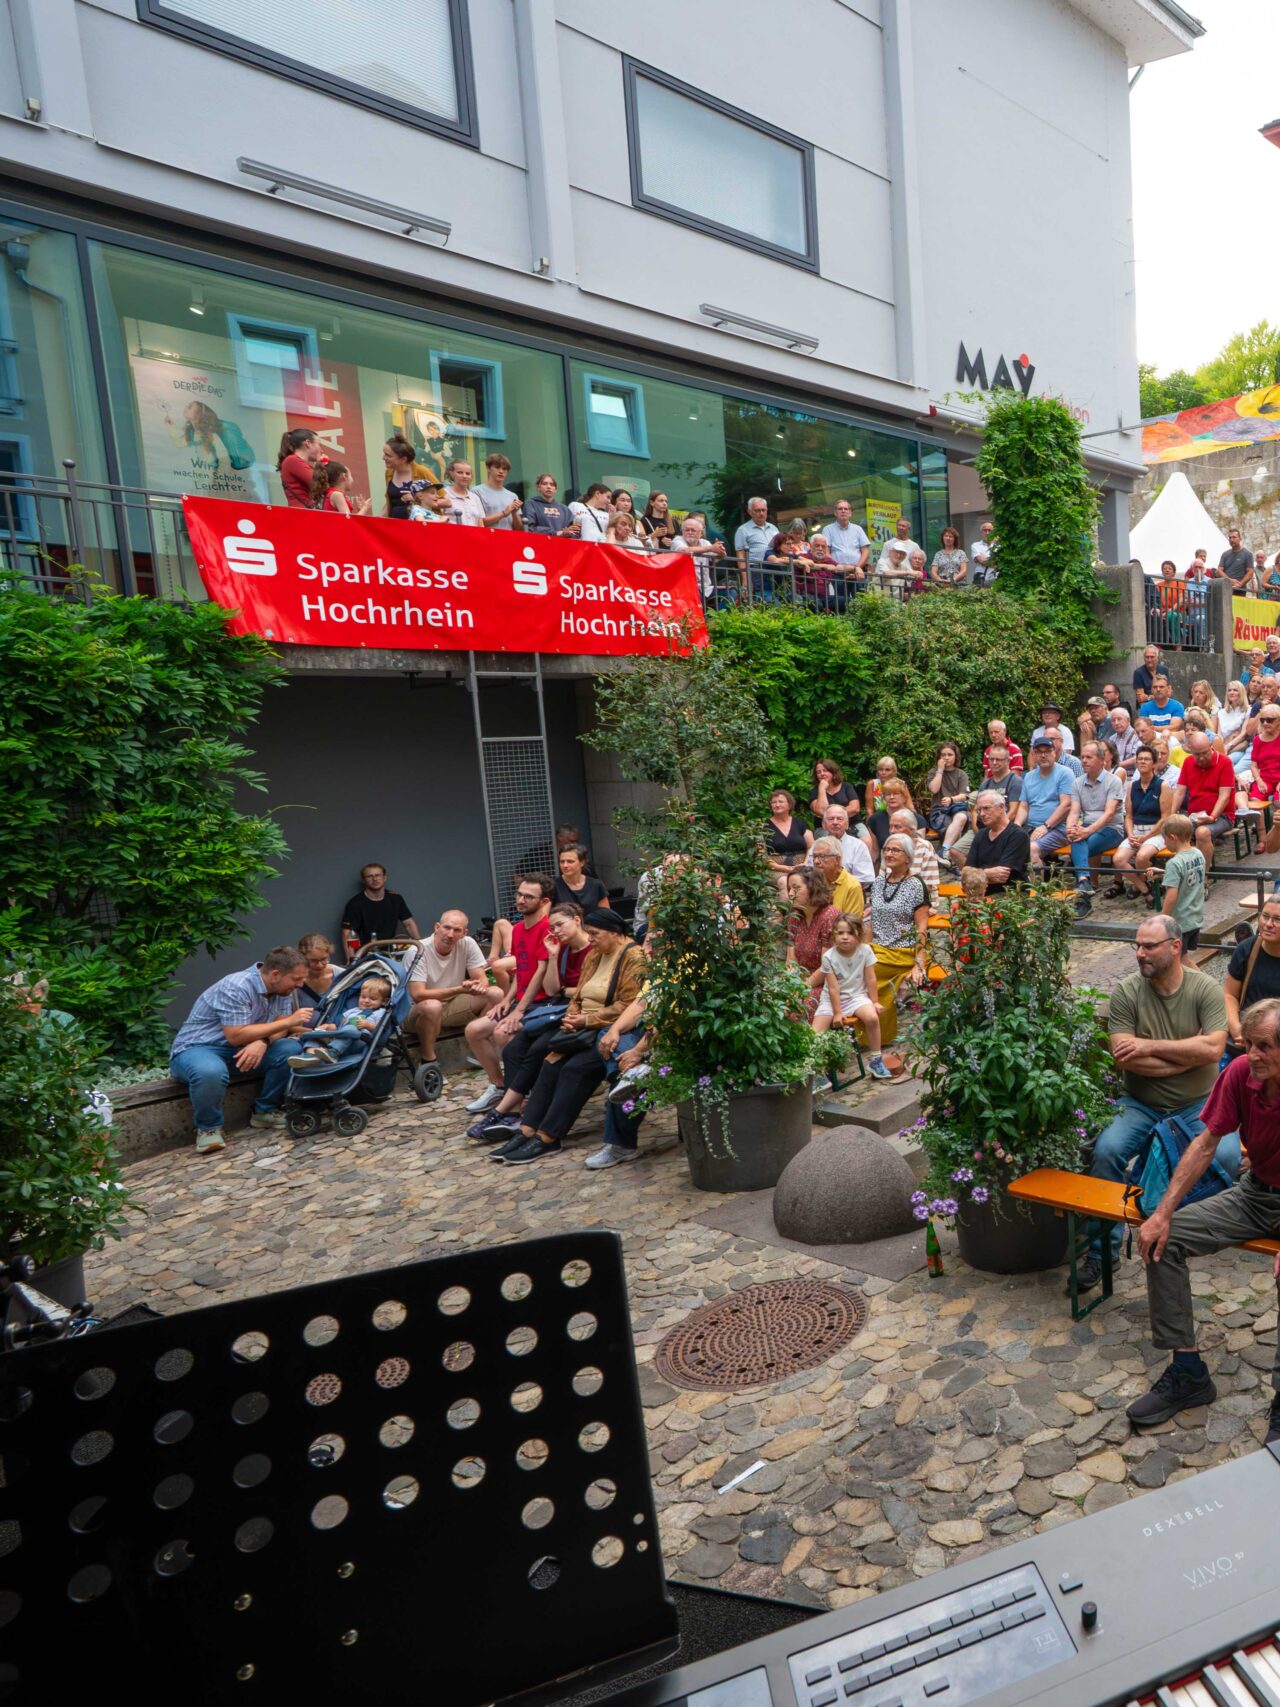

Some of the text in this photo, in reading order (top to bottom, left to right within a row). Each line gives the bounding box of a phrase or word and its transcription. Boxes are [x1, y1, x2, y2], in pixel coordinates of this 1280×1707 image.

[956, 339, 1036, 400] MAY
[305, 367, 345, 454] ALE
[173, 470, 210, 479] machen
[296, 553, 469, 590] Sparkasse
[559, 575, 672, 607] Sparkasse
[301, 594, 474, 628] Hochrhein
[1183, 1556, 1233, 1585] VIVO
